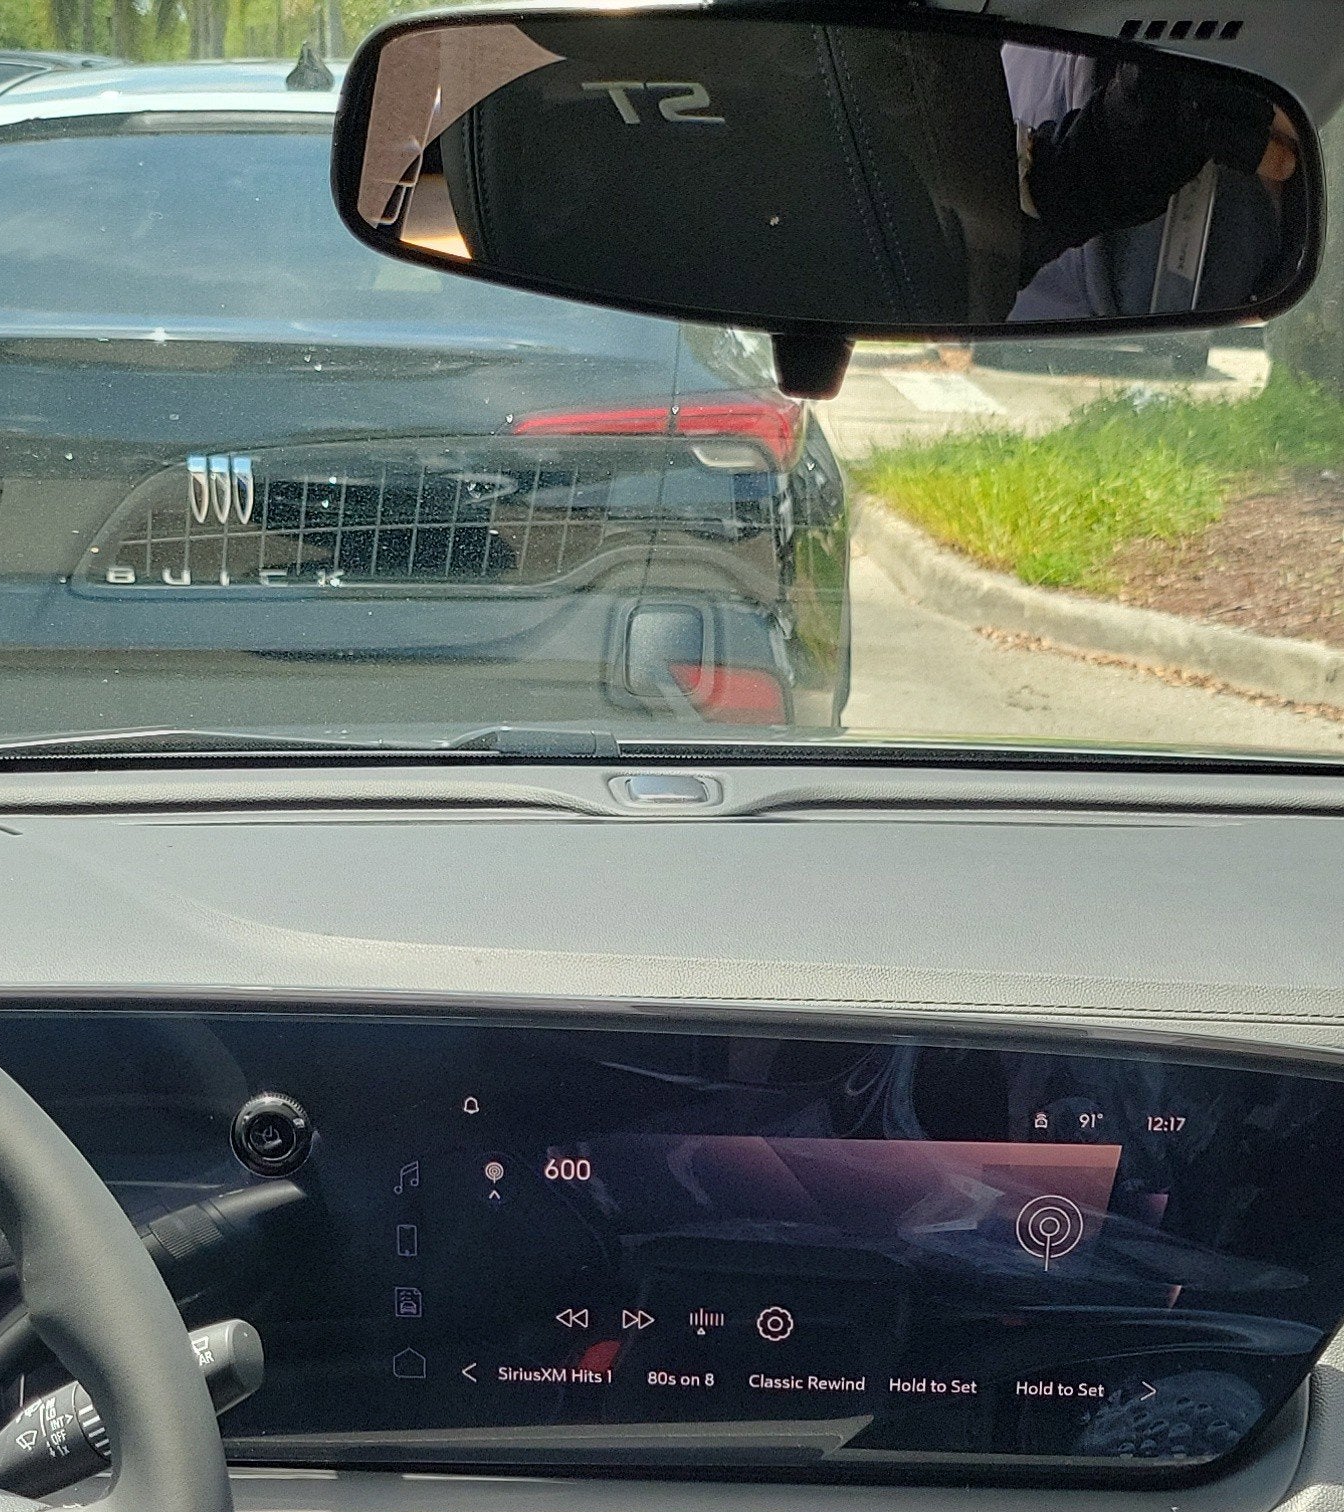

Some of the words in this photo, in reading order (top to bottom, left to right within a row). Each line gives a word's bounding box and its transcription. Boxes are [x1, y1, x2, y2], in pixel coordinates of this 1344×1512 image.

[106, 566, 344, 587] BUICK
[1147, 1116, 1186, 1131] 12:17
[545, 1159, 591, 1181] 600
[498, 1367, 567, 1382] SiriusXM
[571, 1370, 602, 1383] Hits
[607, 1370, 612, 1383] 1
[647, 1371, 677, 1385] 80s
[680, 1374, 700, 1385] on
[705, 1373, 715, 1386] 8
[749, 1374, 803, 1389] Classic
[807, 1376, 865, 1391] Rewind
[889, 1377, 926, 1392] Hold
[930, 1380, 947, 1392] to
[951, 1380, 977, 1393] Set
[1016, 1381, 1053, 1395] Hold
[1057, 1383, 1074, 1396] to
[1078, 1384, 1105, 1397] Set
[50, 1429, 67, 1446] OFF
